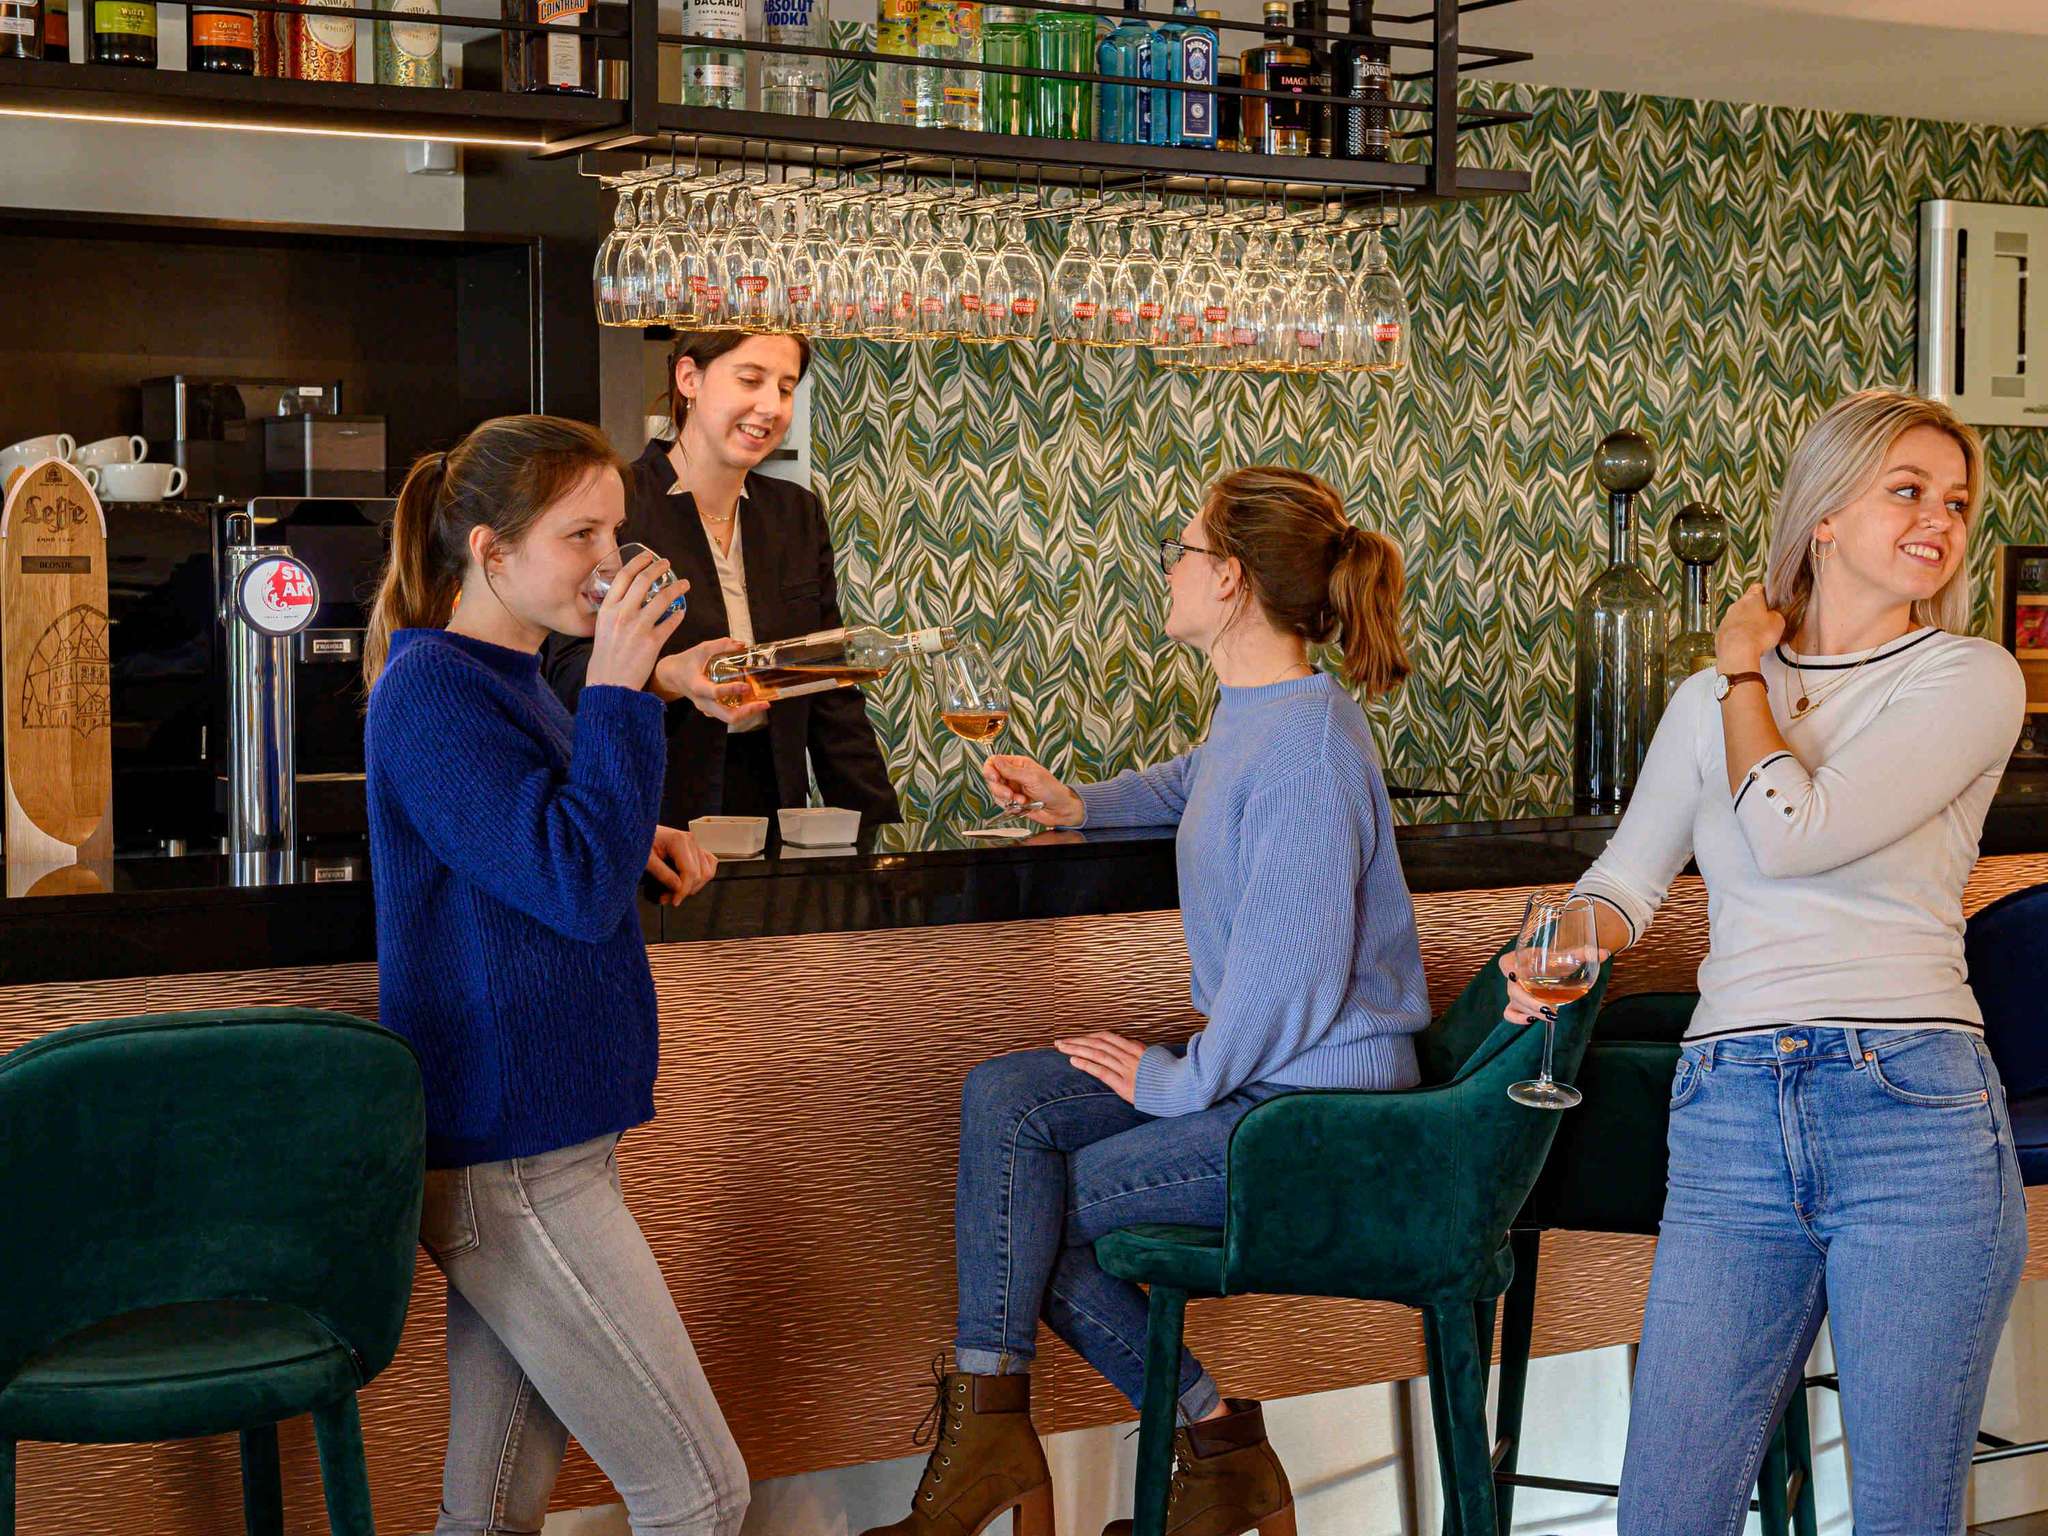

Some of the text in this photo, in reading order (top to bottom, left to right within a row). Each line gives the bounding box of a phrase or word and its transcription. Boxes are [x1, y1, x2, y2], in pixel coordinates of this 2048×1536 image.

[764, 0, 814, 12] ABSOLUT
[766, 12, 808, 26] VODKA
[21, 496, 88, 533] Leffe
